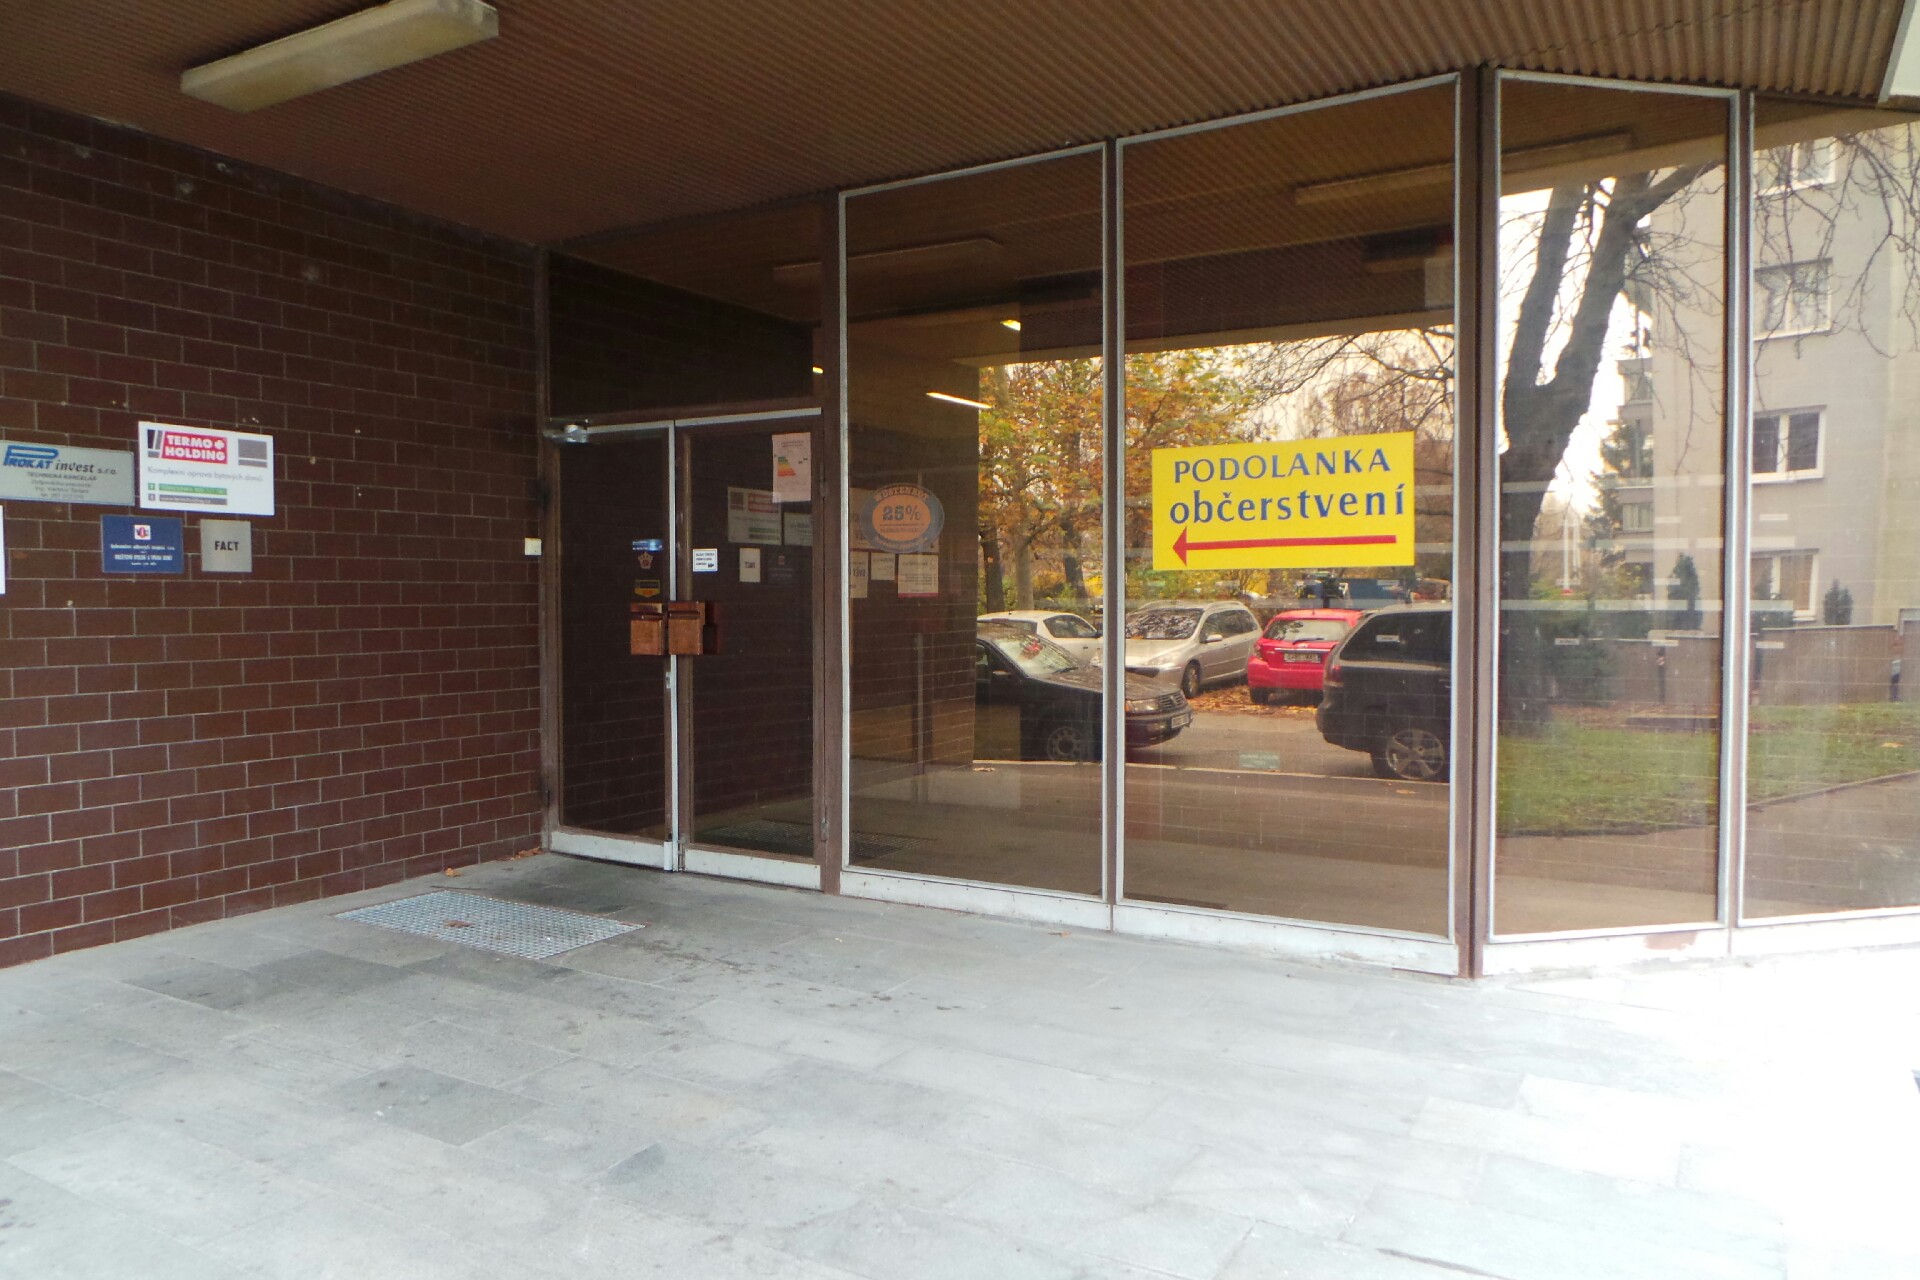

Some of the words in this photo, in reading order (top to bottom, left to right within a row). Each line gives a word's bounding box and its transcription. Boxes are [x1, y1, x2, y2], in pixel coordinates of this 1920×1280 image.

[167, 435, 212, 448] TERMO
[3, 445, 58, 469] PROKAT
[56, 460, 94, 473] invest
[97, 467, 118, 475] s.r.o.
[165, 447, 225, 461] HOLDING
[1174, 448, 1391, 484] PODOLANKA
[1170, 483, 1406, 524] občerstvení
[882, 505, 921, 521] 25%
[214, 540, 239, 551] FACT
